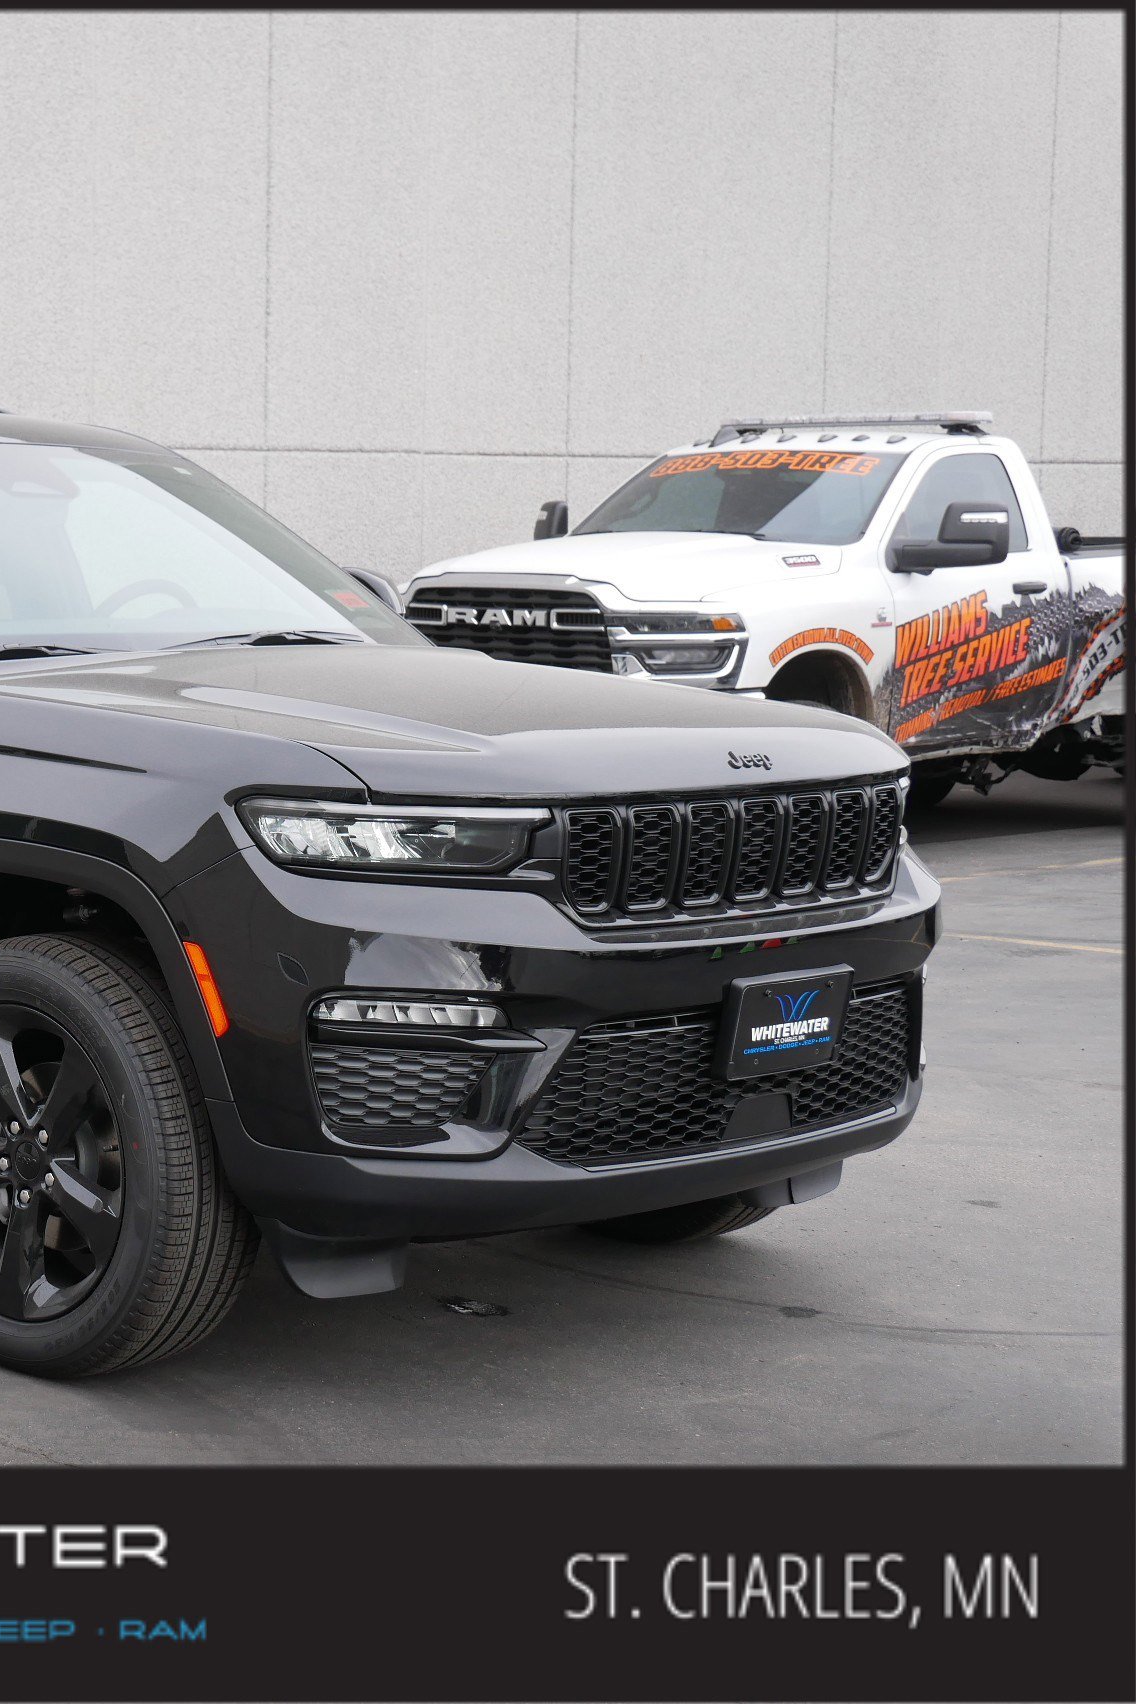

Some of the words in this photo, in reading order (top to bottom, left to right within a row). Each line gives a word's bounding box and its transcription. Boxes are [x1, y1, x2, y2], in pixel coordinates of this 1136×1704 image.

[447, 607, 548, 627] RAM
[895, 589, 988, 669] WILLIAMS
[900, 650, 954, 708] TREE
[947, 617, 1033, 687] SERVICE
[727, 751, 772, 771] Jeep
[751, 1016, 830, 1041] WHITEWATER
